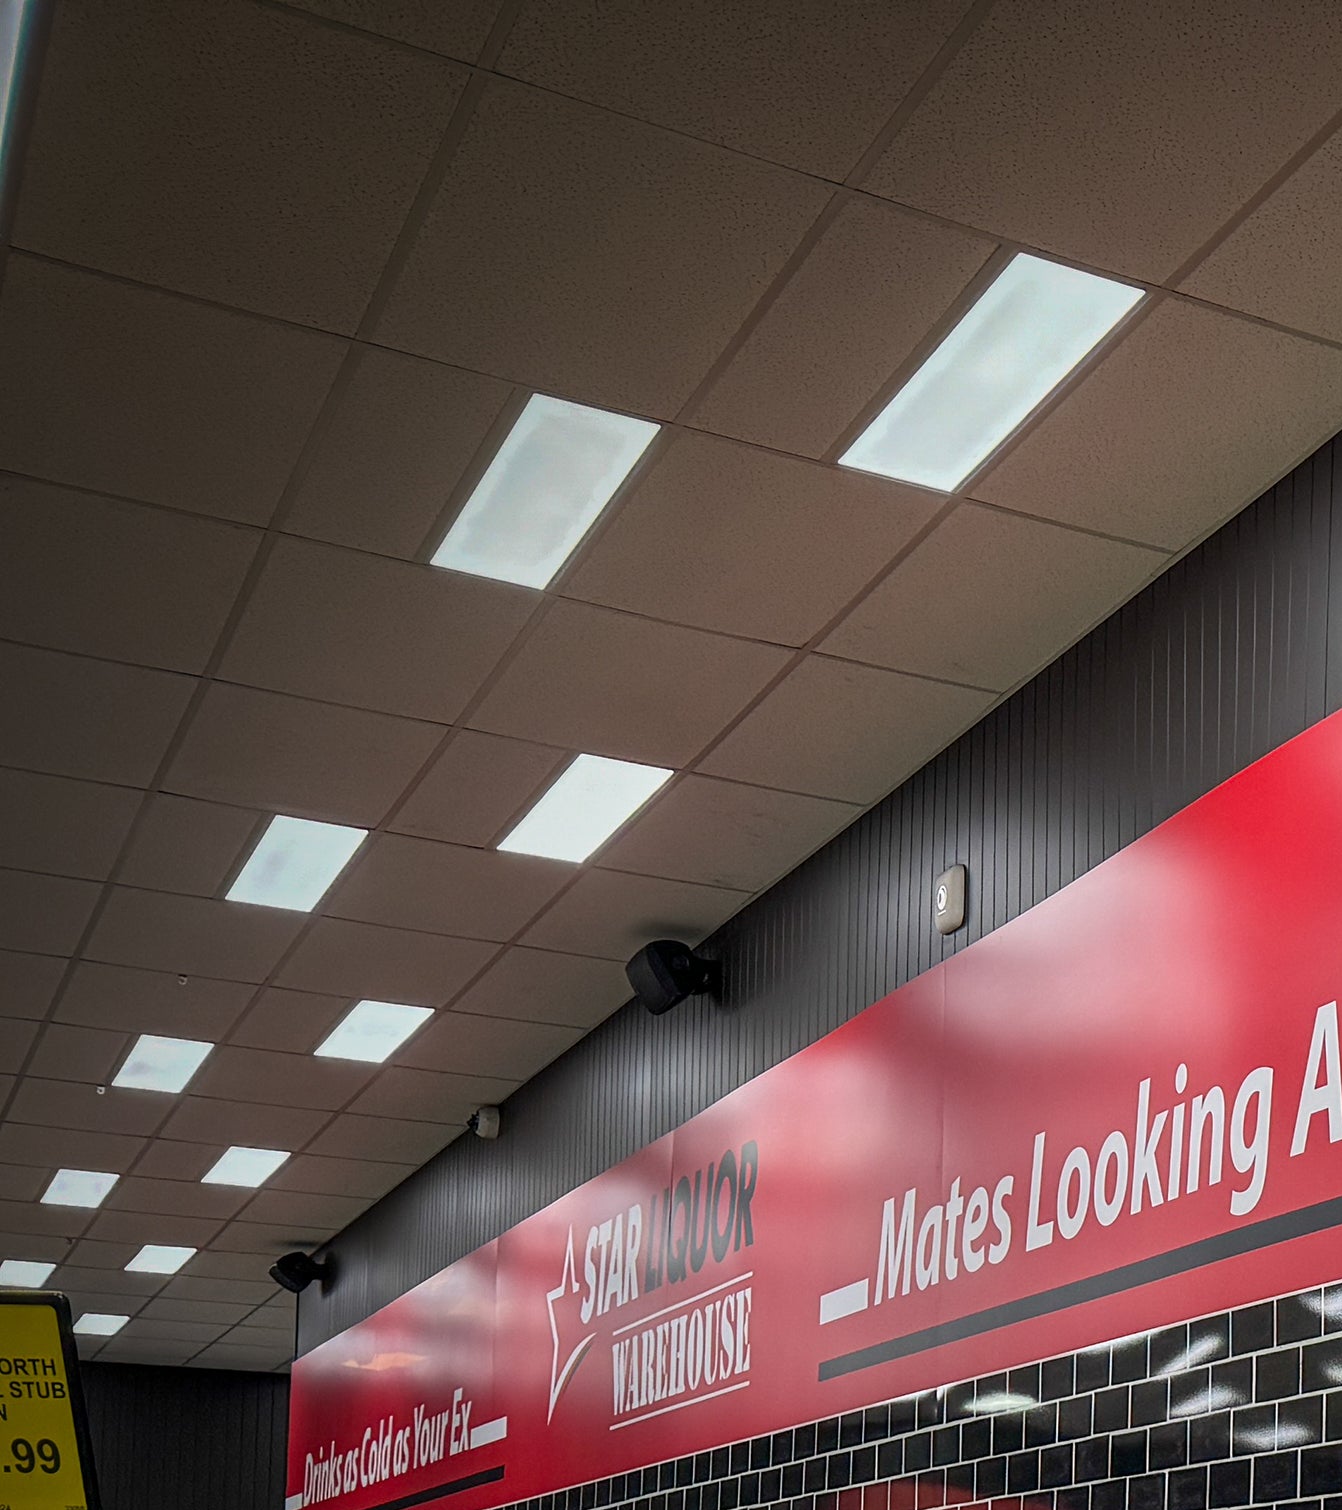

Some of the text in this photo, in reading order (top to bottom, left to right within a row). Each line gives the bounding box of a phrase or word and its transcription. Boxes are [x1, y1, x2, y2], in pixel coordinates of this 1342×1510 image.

[580, 1140, 758, 1324] STAR LIQUOR
[873, 1172, 1012, 1304] Mates
[1024, 1061, 1276, 1253] Looking
[10, 1382, 66, 1399] STUB
[613, 1287, 752, 1415] WAREHOUSE
[304, 1388, 472, 1507] Drinks as Cold as Your Ex
